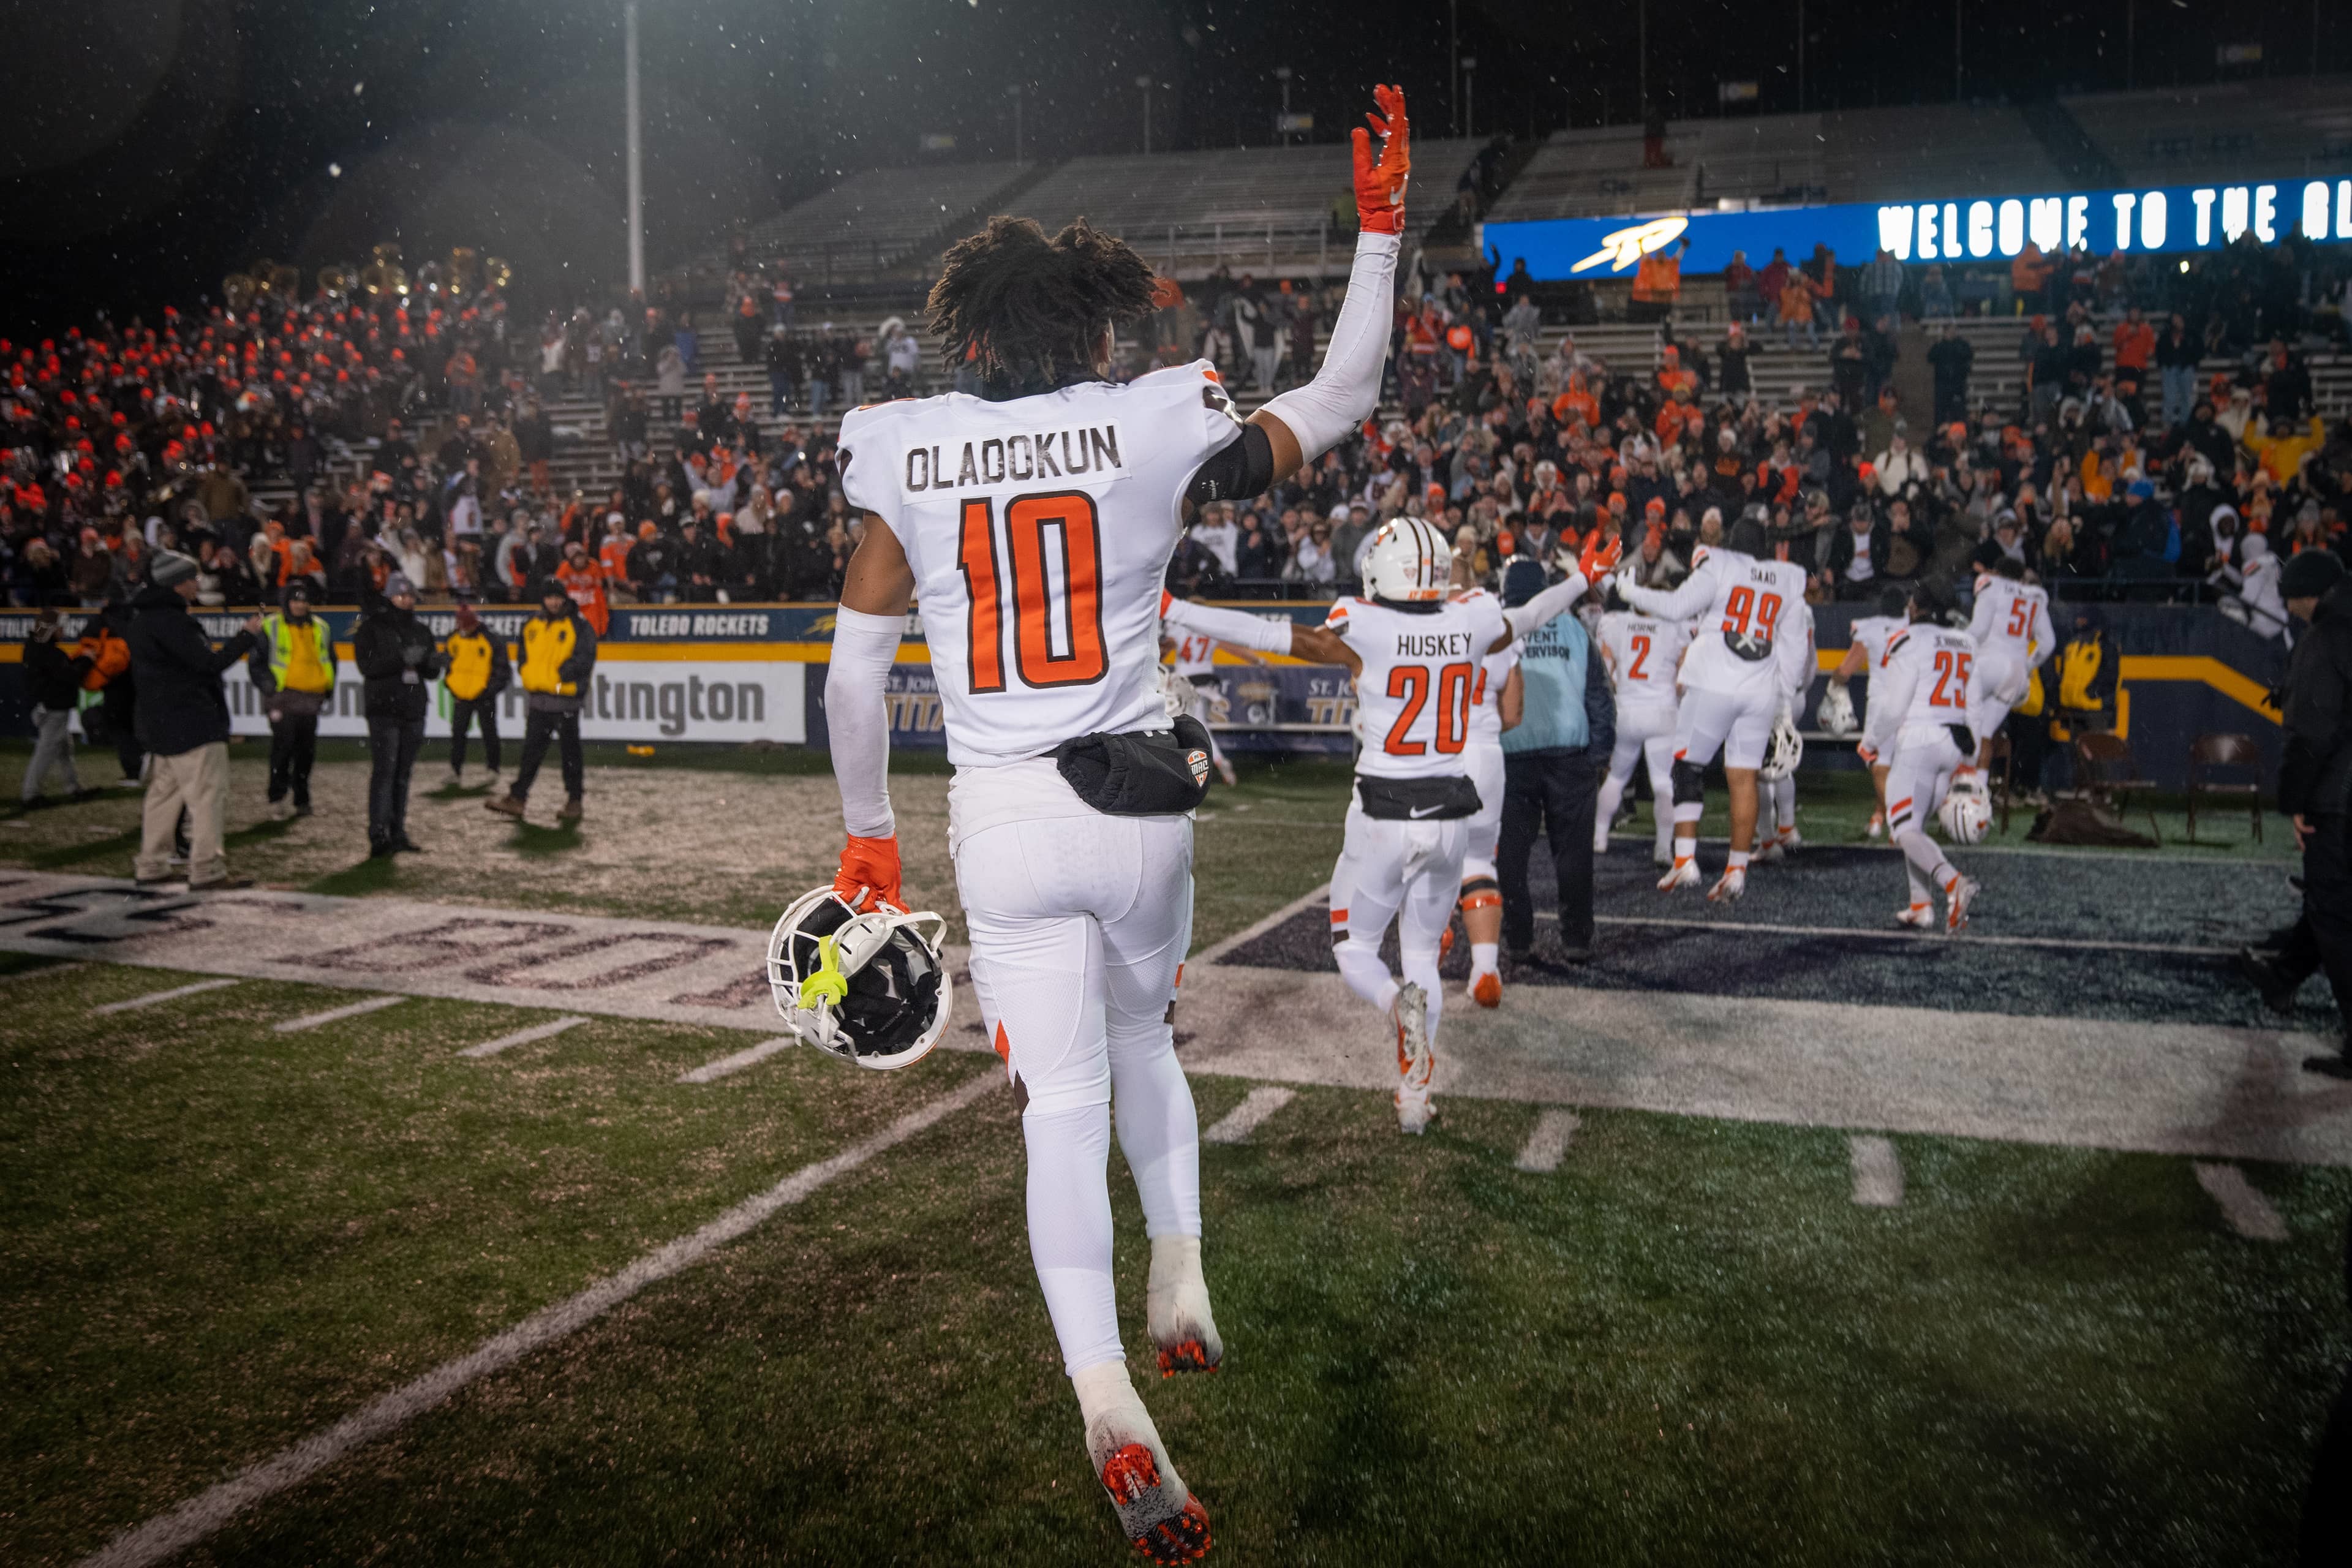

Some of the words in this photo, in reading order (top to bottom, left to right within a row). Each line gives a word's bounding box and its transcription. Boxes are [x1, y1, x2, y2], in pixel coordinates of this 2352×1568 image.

[1878, 196, 2088, 259] WELCOME
[2113, 191, 2166, 250] TO
[2192, 186, 2276, 245] THE
[906, 424, 1122, 492] OLADOKUN
[957, 489, 1109, 695] 10
[1751, 567, 1776, 584] SAAD
[630, 614, 688, 636] TOLEDO
[693, 614, 769, 636] ROCKETS
[1721, 586, 1782, 641] 99
[2007, 597, 2038, 641] 51
[1180, 636, 1210, 663] 47
[1397, 633, 1472, 657] HUSKEY
[1523, 631, 1558, 647] VENT
[1525, 646, 1570, 660] ERVISOR
[1628, 635, 1650, 680] 2
[1930, 650, 1972, 708] 25
[1384, 662, 1472, 755] 20
[1191, 760, 1209, 775] MAC
